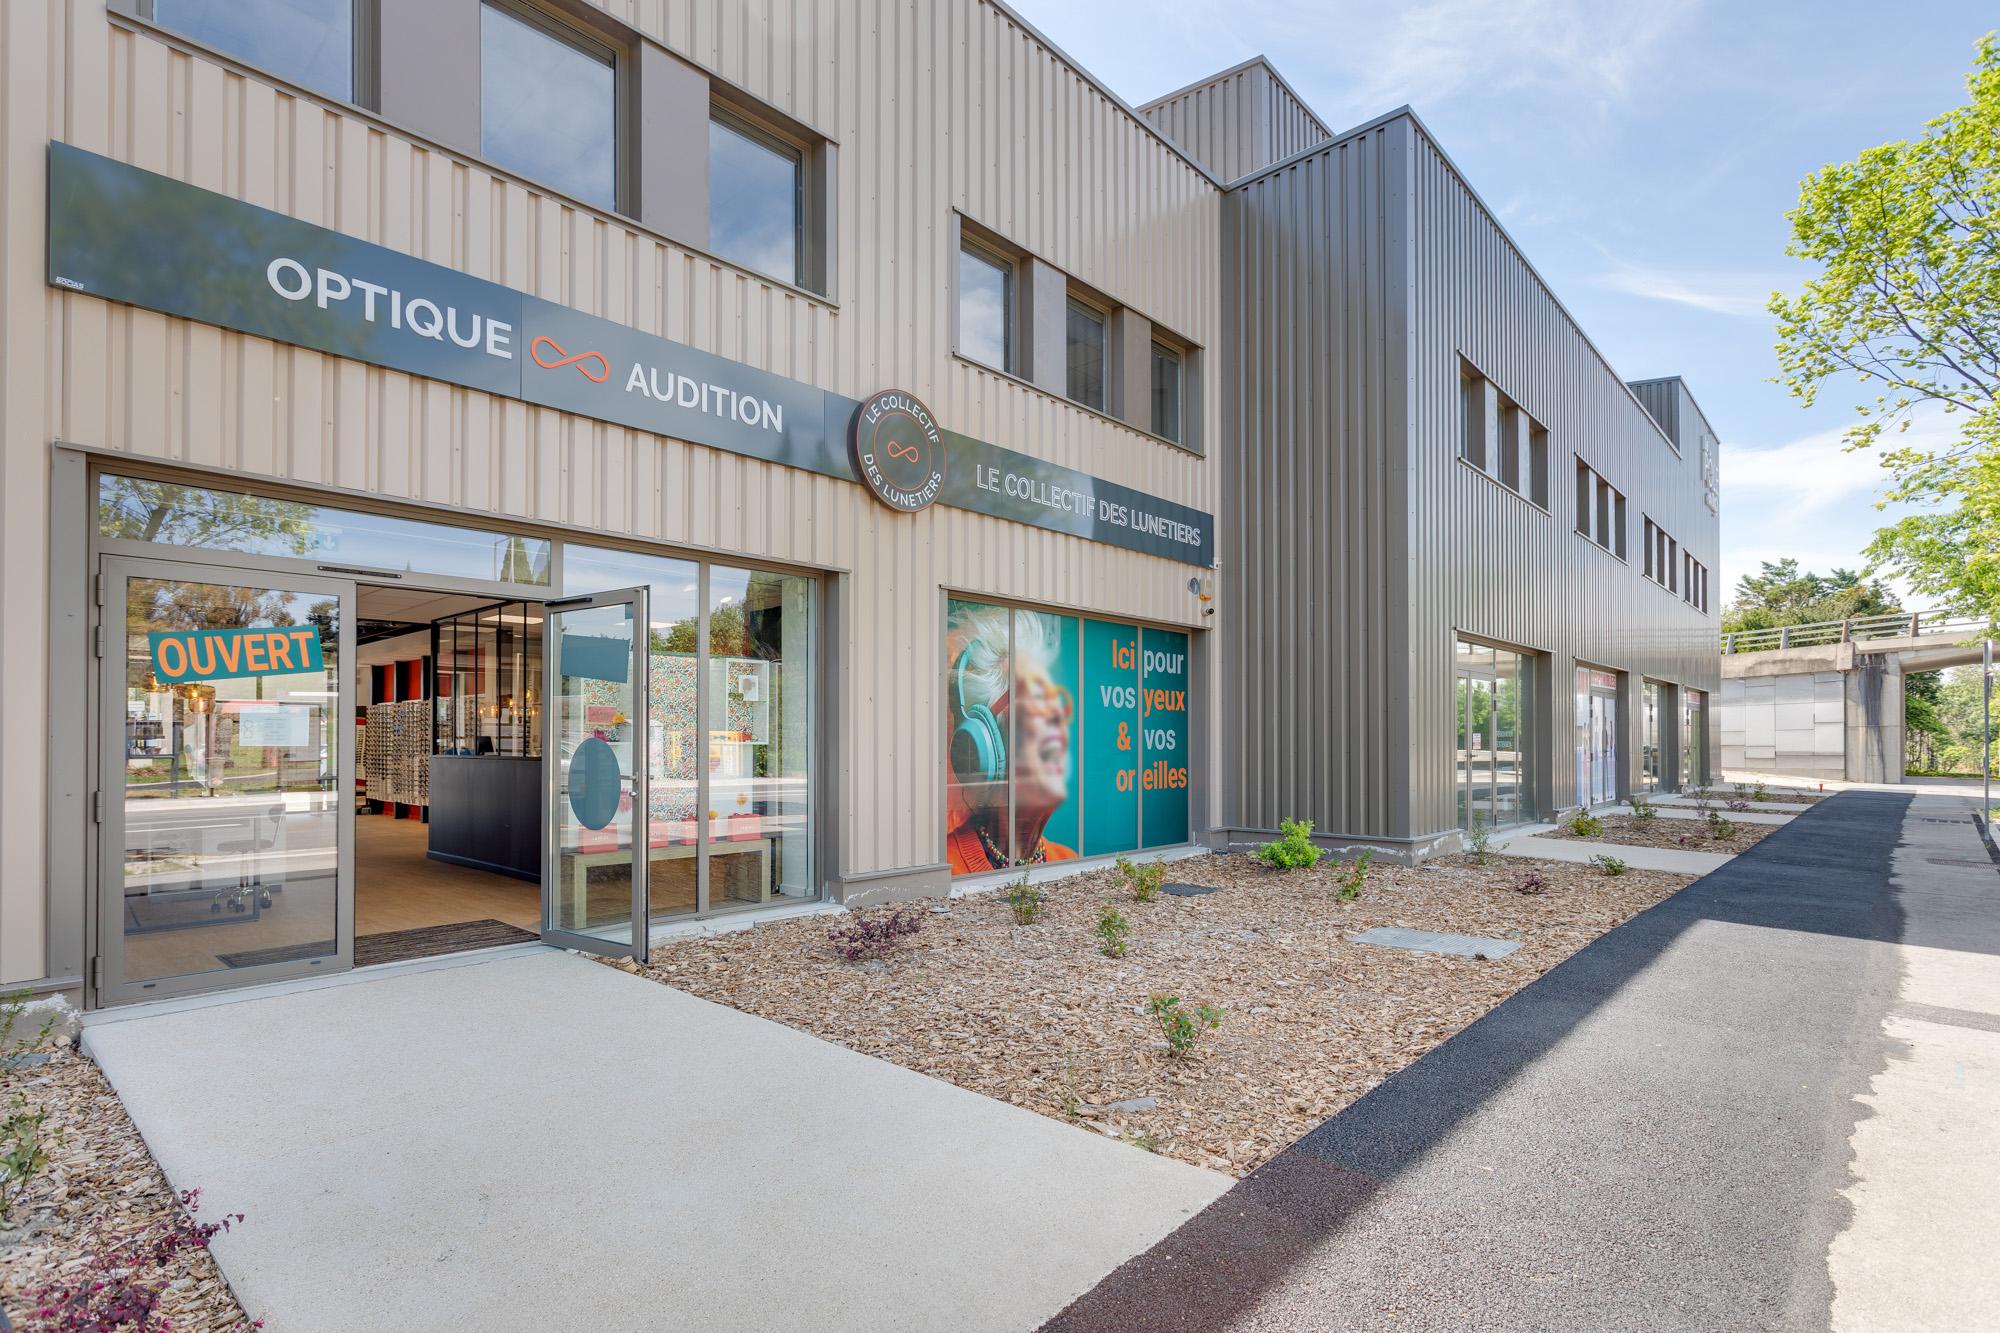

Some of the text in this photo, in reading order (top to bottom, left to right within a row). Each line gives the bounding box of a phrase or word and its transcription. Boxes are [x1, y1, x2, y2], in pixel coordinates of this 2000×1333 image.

[267, 257, 513, 360] OPTIQUE
[625, 363, 783, 433] AUDITION
[866, 395, 940, 443] LE COLLECTIF
[864, 453, 942, 507] DES LUNETIERS
[976, 464, 1202, 547] LE COLLECTIF DES LUNETIERS
[157, 631, 314, 677] OUVERT
[1112, 639, 1184, 678] Ici pour
[1100, 685, 1186, 718] vos yeux
[1117, 722, 1176, 750] & vos
